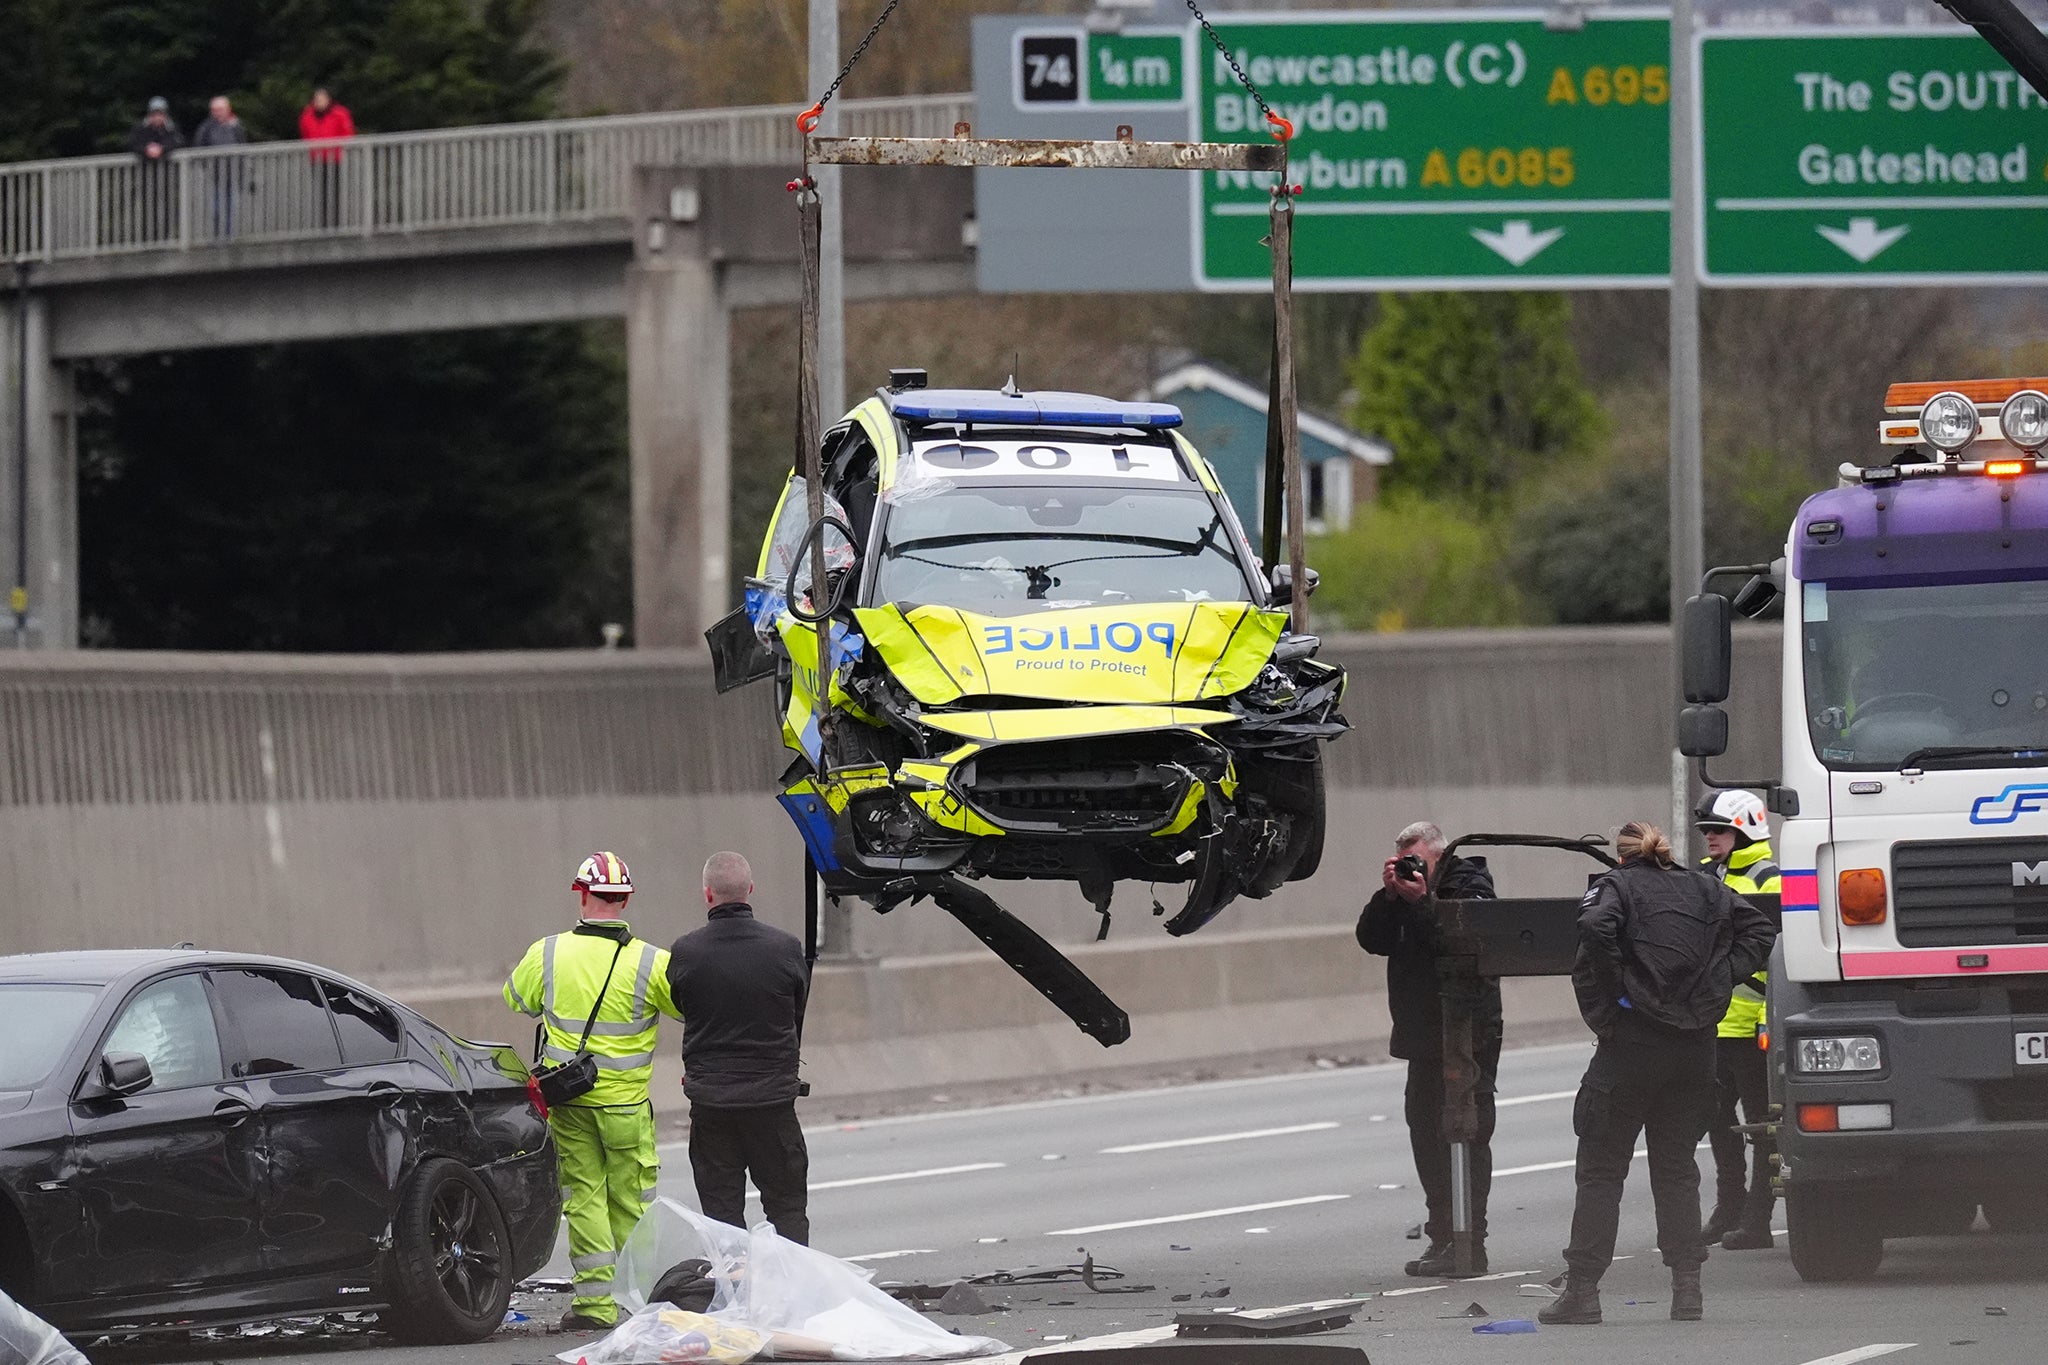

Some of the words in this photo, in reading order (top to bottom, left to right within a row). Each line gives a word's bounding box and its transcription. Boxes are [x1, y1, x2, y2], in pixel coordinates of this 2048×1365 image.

[1025, 54, 1073, 88] 74
[1213, 46, 1436, 86] Newcastle
[1444, 40, 1527, 88] (C)
[1794, 72, 1872, 111] The
[1799, 143, 2027, 184] Gateshead
[1016, 659, 1064, 670] Proud
[1070, 659, 1085, 670] to
[1090, 660, 1147, 676] Protect
